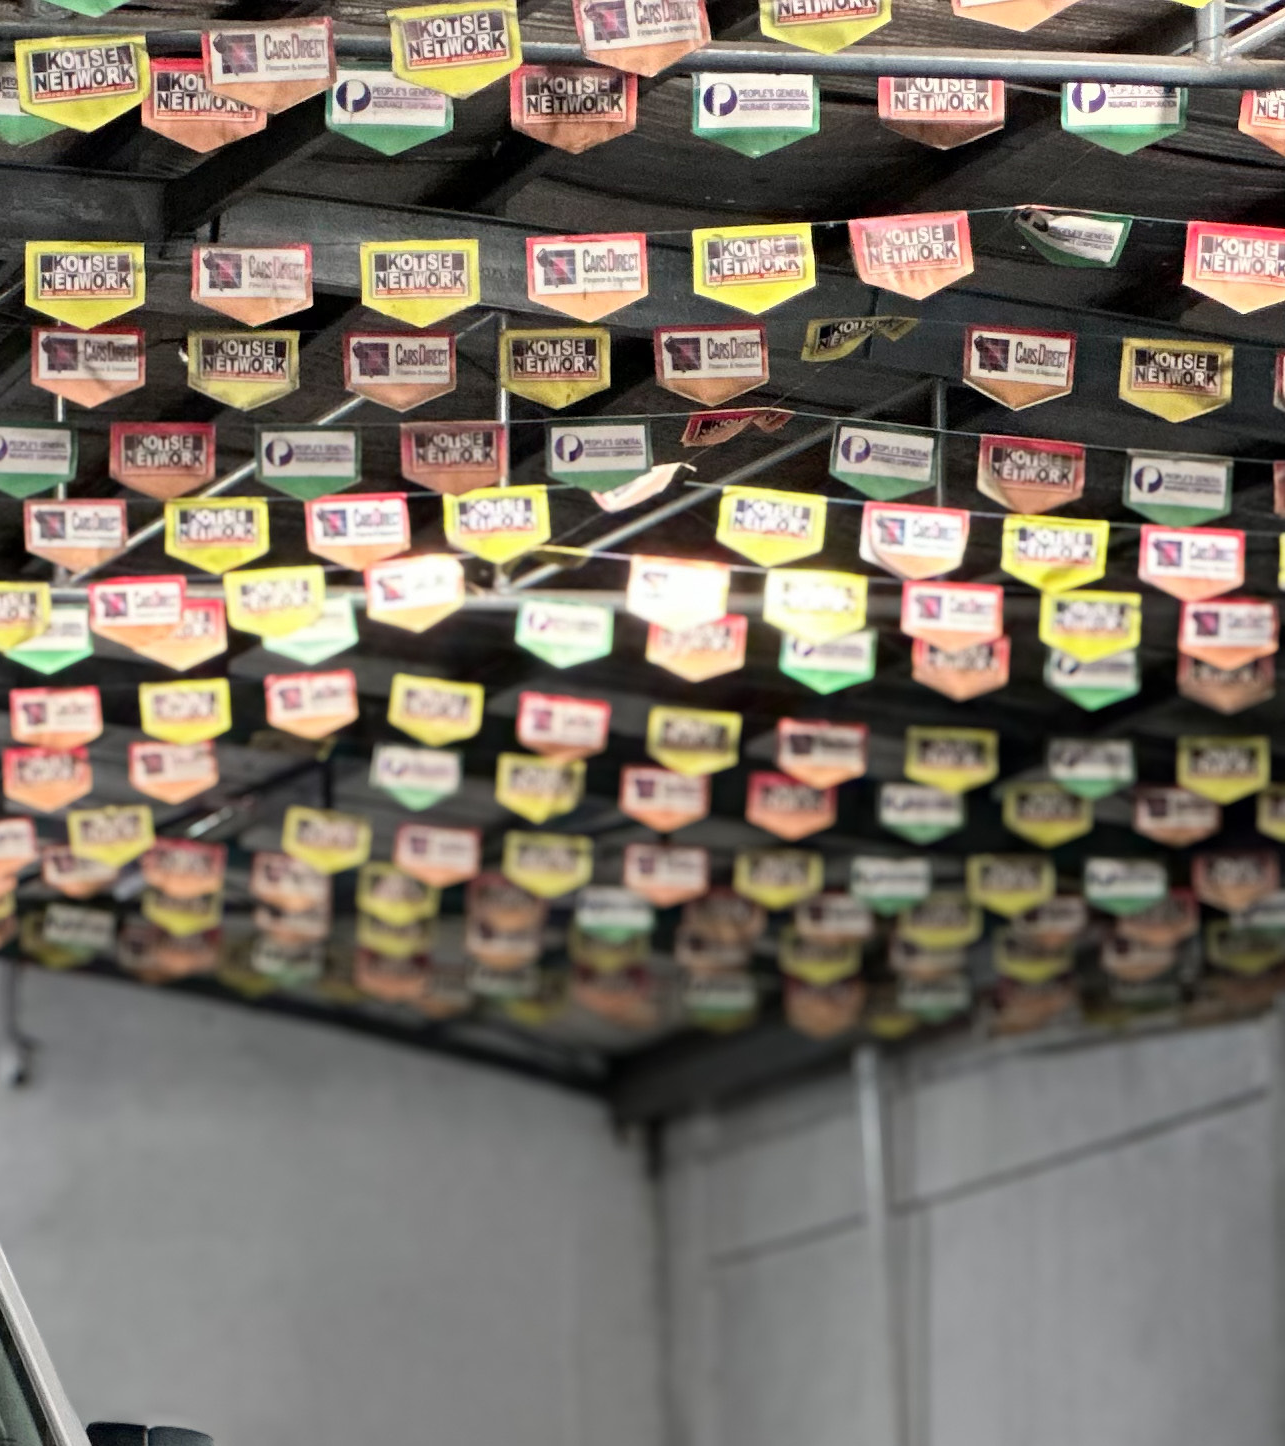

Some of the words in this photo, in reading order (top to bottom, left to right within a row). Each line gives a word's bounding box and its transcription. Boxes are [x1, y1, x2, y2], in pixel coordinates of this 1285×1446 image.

[419, 18, 490, 38] KOTSE
[408, 33, 506, 58] NETWORK
[48, 50, 118, 70] KOTSE
[35, 68, 134, 91] NETWORK
[540, 76, 610, 94] KOTSE
[527, 94, 622, 113] NETWORK
[894, 93, 989, 111] NETWORK
[879, 230, 944, 247] KOTSE
[1213, 239, 1280, 256] KOTSE
[722, 240, 785, 259] KOTSE
[869, 244, 957, 265] NETWORK
[54, 255, 116, 272] KOTSE
[389, 253, 451, 271] KOTSE
[710, 256, 800, 278] NETWORK
[42, 273, 130, 288] NETWORK
[376, 271, 465, 288] NETWORK
[216, 340, 274, 356] KOTSE
[527, 340, 585, 355] KOTSE
[203, 357, 286, 372] NETWORK
[514, 357, 596, 372] NETWORK
[1148, 352, 1206, 369] KOTSE
[1135, 367, 1217, 387] NETWORK
